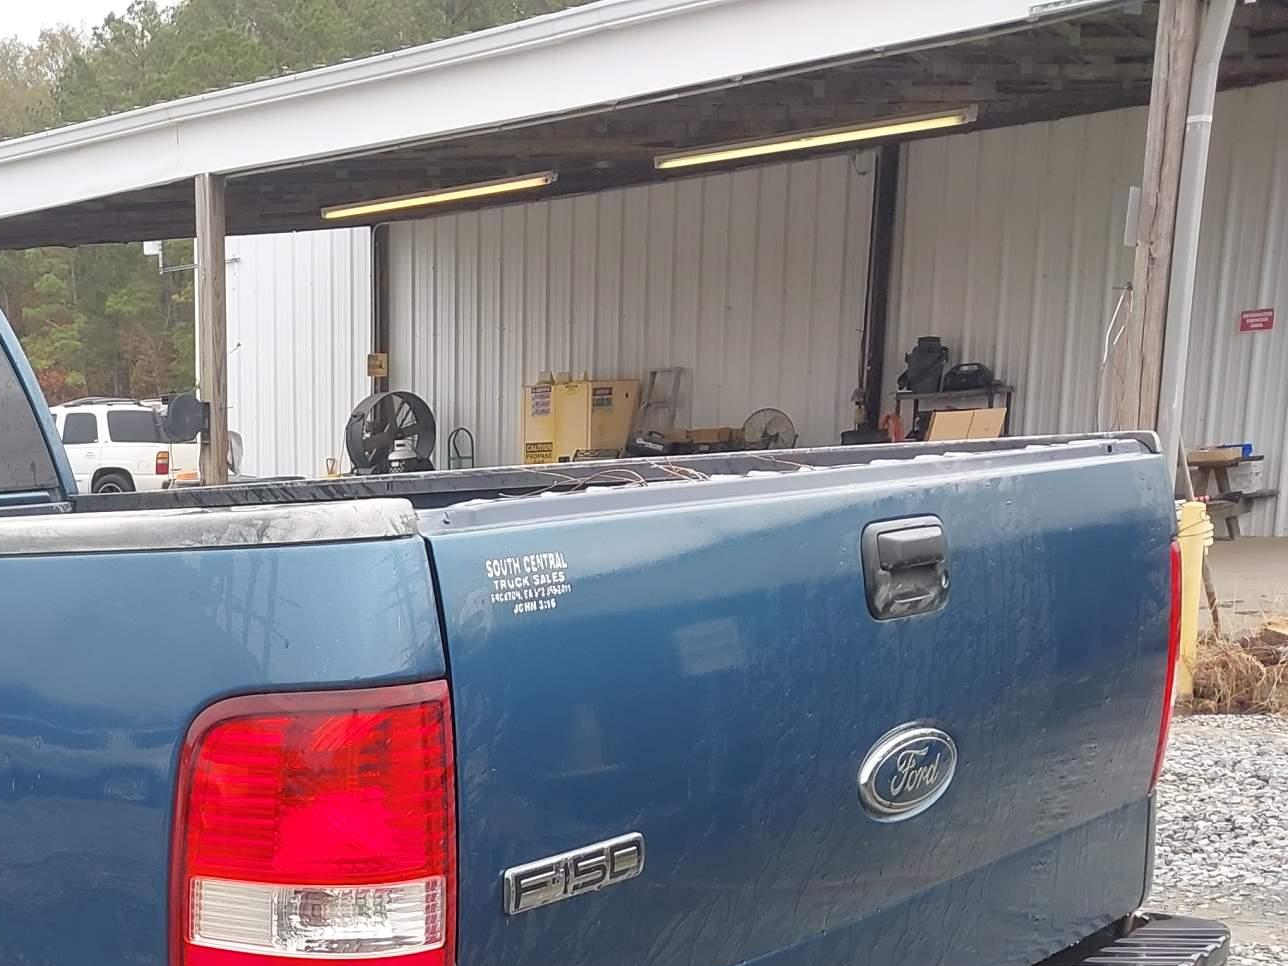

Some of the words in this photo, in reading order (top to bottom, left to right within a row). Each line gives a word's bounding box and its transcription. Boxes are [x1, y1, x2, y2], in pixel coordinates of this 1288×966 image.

[526, 444, 552, 452] CAUTION
[486, 557, 521, 577] SOUTH
[524, 552, 567, 573] CENTRAL
[493, 576, 530, 590] TRUCK
[533, 571, 565, 586] SALES
[513, 601, 537, 614] JOHN
[890, 746, 941, 796] Ford
